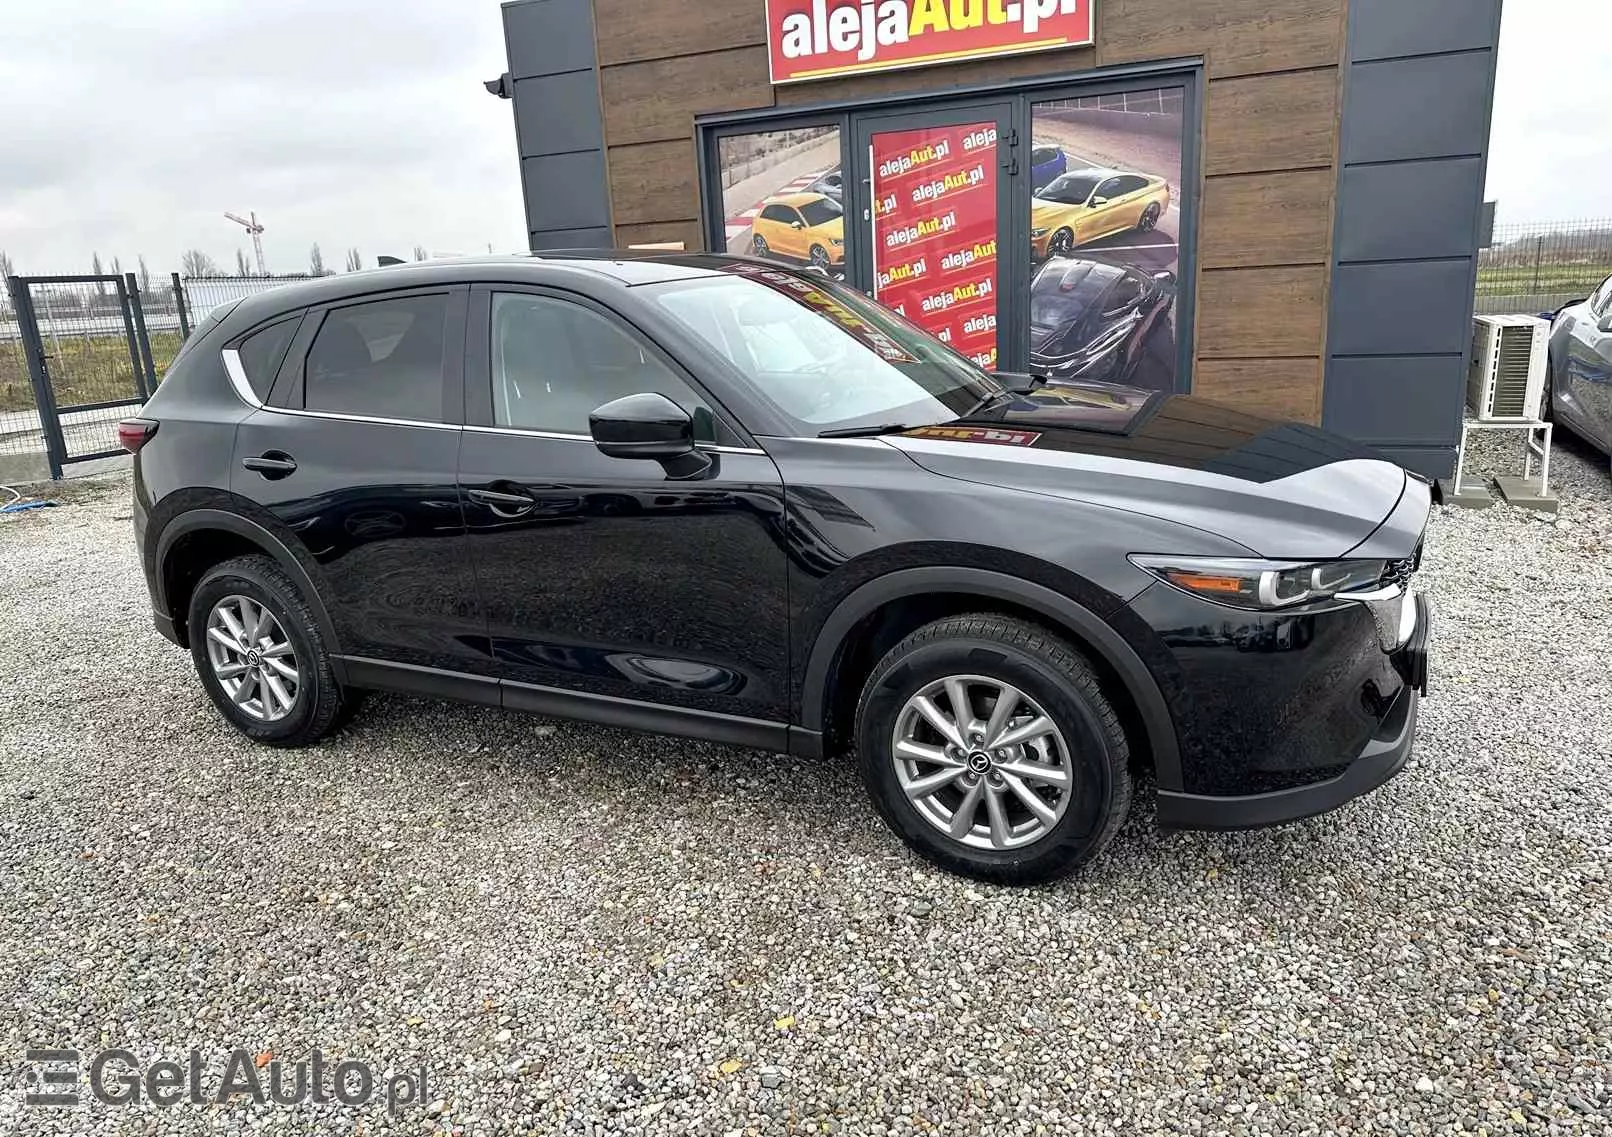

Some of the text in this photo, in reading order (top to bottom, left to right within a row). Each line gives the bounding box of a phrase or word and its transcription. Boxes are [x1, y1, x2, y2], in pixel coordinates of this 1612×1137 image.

[962, 127, 997, 150] aleja
[879, 139, 950, 177] alejaAut.pl
[911, 164, 984, 202] alejaAut.pl
[885, 211, 956, 247] alejaAut.pl
[940, 241, 997, 270] alejaAut
[921, 278, 993, 312] alejaAut.pl
[963, 314, 997, 334] aleja
